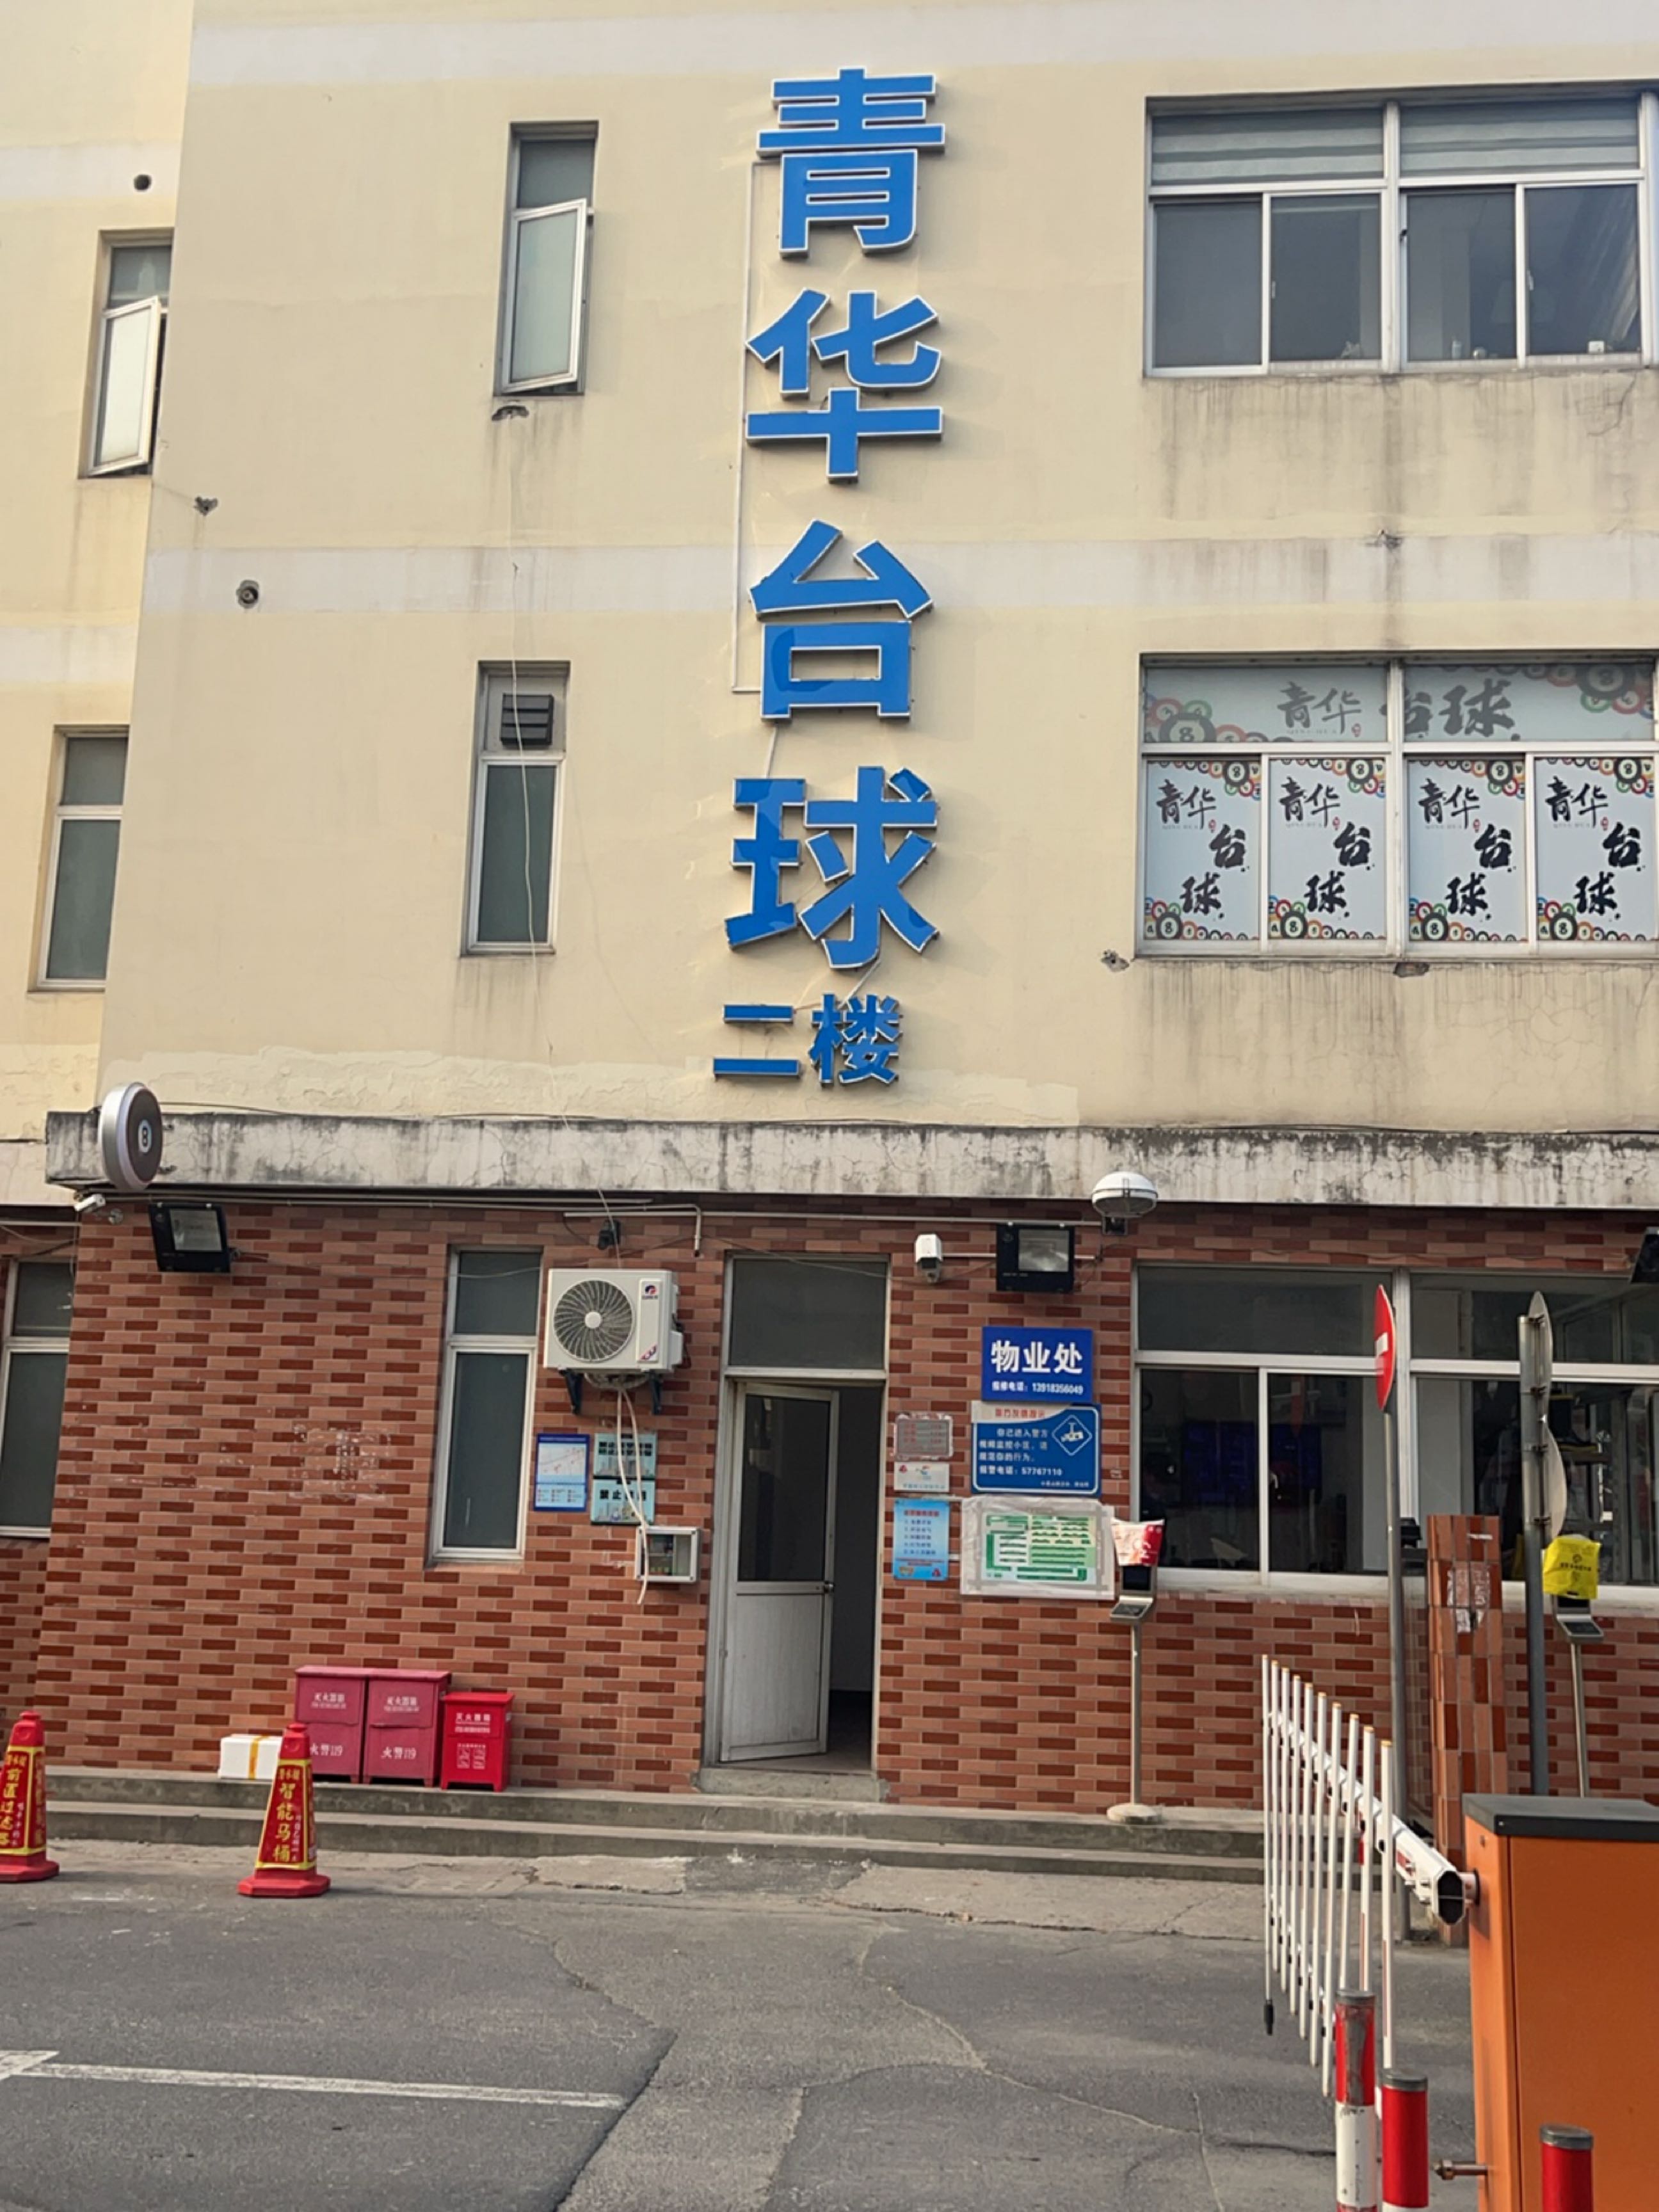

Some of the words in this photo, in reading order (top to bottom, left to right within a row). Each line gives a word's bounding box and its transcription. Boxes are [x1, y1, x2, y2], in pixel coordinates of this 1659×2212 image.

[725, 67, 945, 970] 青华台球
[1179, 726, 1195, 742] 8
[712, 993, 901, 1085] 二楼
[141, 1127, 148, 1147] 8
[990, 1340, 1083, 1374] 物业处
[273, 1782, 296, 1863] 智能马桶
